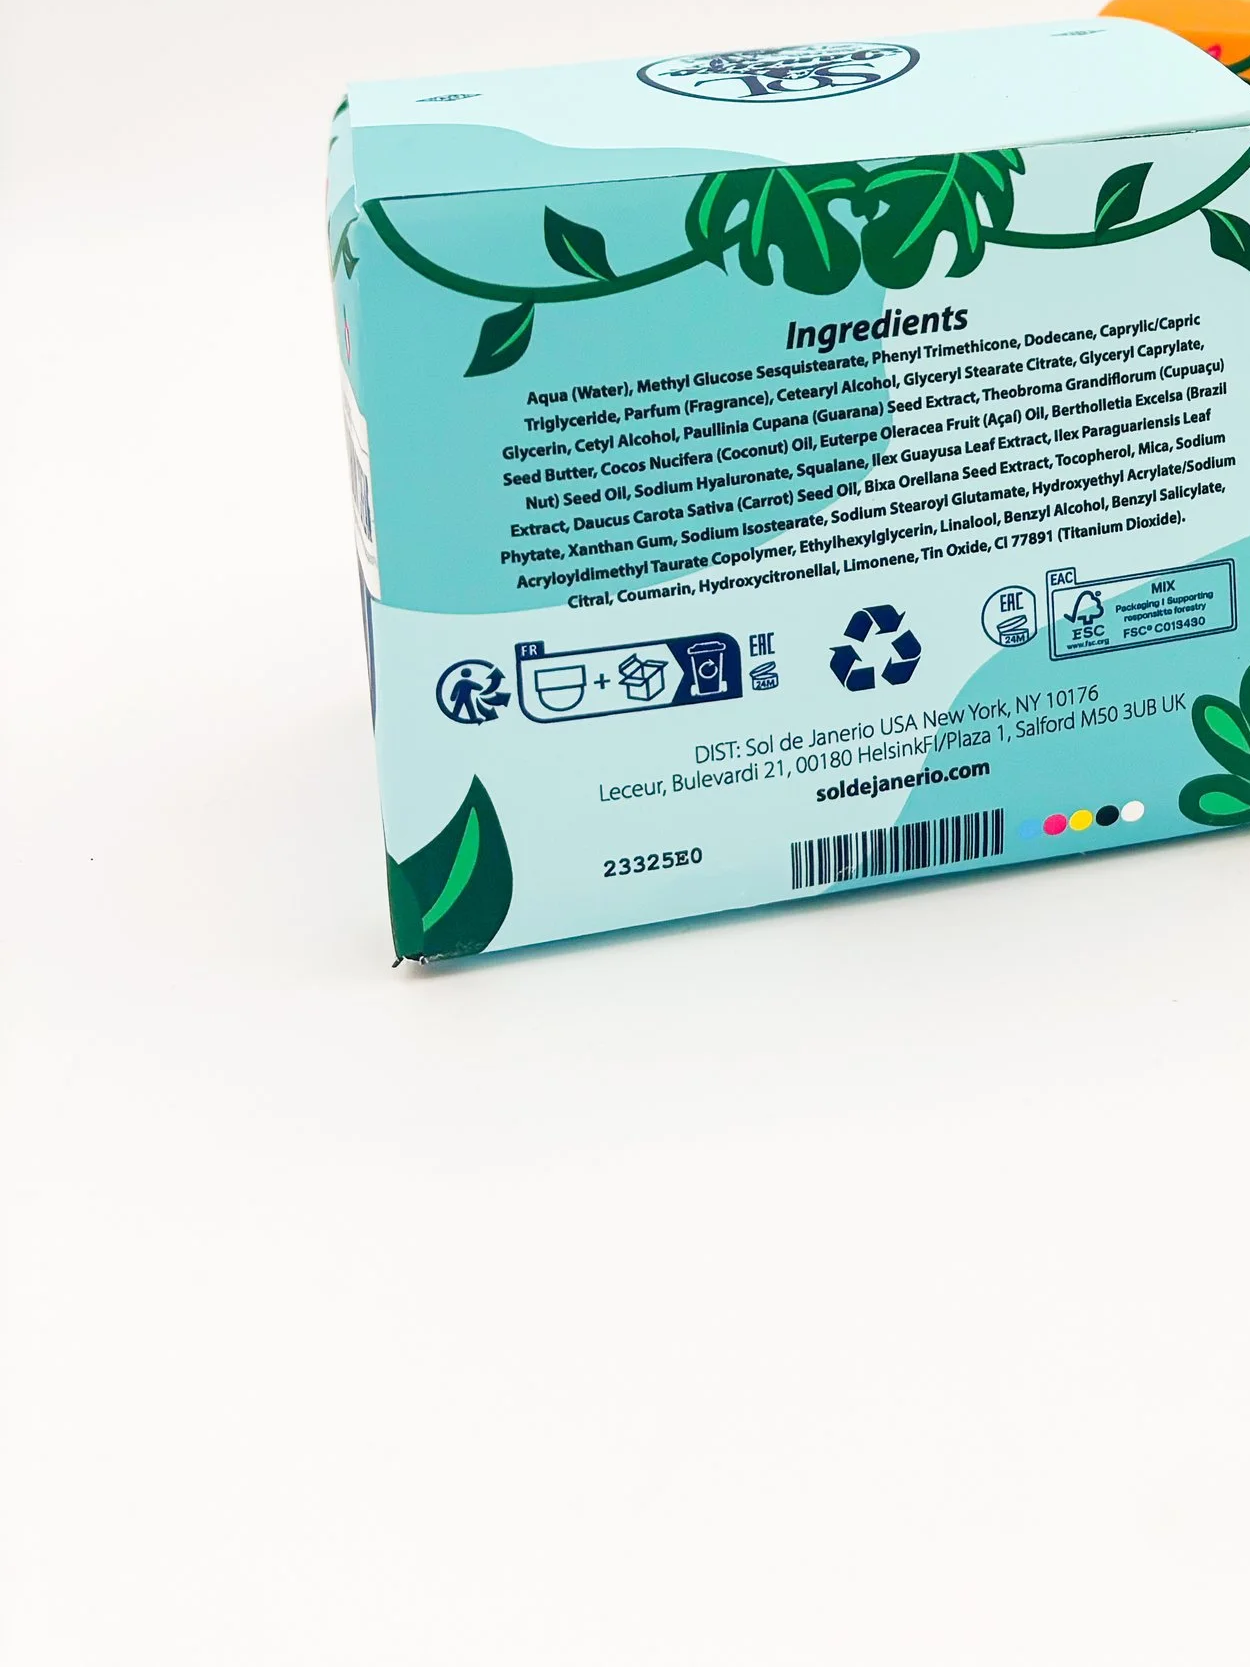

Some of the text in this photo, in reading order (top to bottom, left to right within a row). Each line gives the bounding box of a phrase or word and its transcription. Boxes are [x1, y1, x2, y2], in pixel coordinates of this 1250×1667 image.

[694, 63, 881, 98] SOL
[785, 305, 969, 354] Ingredients
[526, 313, 1201, 408] Aqua (Water), Methyl Glucose Sesquistearate, Phenyl Trimethicone, Dodecane, Caprylic/Capric
[502, 357, 1225, 463] Glycerin, Cetyl Alcohol, Paullinia Cupana (Guarana) Seed Extract, Theobroma Grandiflorum (Cupuaçu)
[523, 339, 1205, 434] Triglyceride, Parfum (Fragrance), Cetearyl Alcohol, Glyceryl Stearate Citrate, Glyceryl Caprylate,
[502, 468, 542, 487] Seed
[544, 466, 598, 483] Butter,
[600, 460, 647, 476] Cocos
[649, 451, 714, 470] Nucifera
[716, 439, 789, 464] (Coconut)
[791, 435, 818, 452] Oil,
[819, 431, 878, 448] Euterpe
[879, 422, 944, 440] Oleracea
[946, 414, 981, 432] Fruit
[1024, 405, 1050, 421] Oil,
[1051, 395, 1133, 418] Bertholletia
[1135, 389, 1184, 407] Excelsa
[1186, 381, 1227, 402] (Brazil
[525, 407, 1212, 510] Nut) Seed Oil, Sodium Hyaluronate, Squalane, Ilex Guayusa Leaf Extract, Ilex Paraguariensis Leaf
[510, 433, 1226, 538] Extract, Daucus Carota Sativa (Carrot) Seed Oil, Bixa Orellana Seed Extract, Tocopherol, Mica, Sodium
[500, 455, 1236, 567] Phytate, Xanthan Gum, Sodium Isostearate, Sodium Stearoyl Glutamate, Hydroxyethyl Acrylate/Sodium
[516, 481, 1226, 590] Acryloyldimethyl Taurate Copolymer, Ethylhexylglycerin, Linalool, Benzyl Alcohol, Benzyl Salicylate,
[1000, 591, 1024, 612] EAC
[1050, 572, 1074, 586] EAC
[1115, 590, 1214, 614] Packaging Supporting
[1151, 580, 1176, 594] MIX
[521, 644, 538, 657] FR
[749, 632, 775, 657] EAC
[1004, 634, 1026, 644] 24M
[599, 780, 667, 802] Leceur,
[672, 762, 759, 793] Bulevardi
[764, 759, 792, 779] 21,
[795, 748, 853, 774] 00180
[997, 724, 1012, 743] 1,
[1015, 711, 1075, 739] Salford
[1080, 705, 1119, 728] M50
[1122, 698, 1157, 720] 3UB
[1162, 692, 1187, 713] UK
[695, 684, 1099, 764] DIST: Sol de Janerio USA New York, NY 10176
[816, 761, 991, 803] soldejanerio.com
[603, 847, 703, 878] 23325E0
